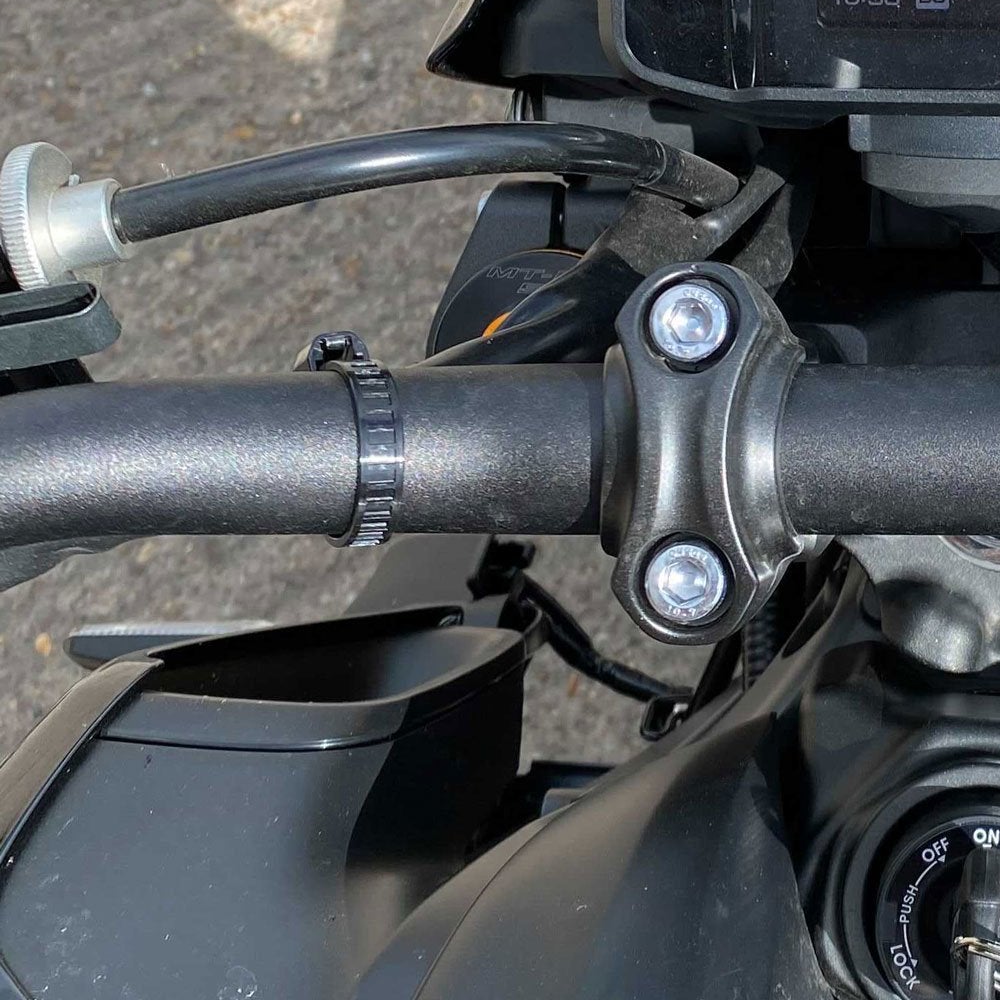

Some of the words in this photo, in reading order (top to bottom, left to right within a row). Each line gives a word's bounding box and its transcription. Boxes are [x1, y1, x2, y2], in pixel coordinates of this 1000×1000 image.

[486, 265, 563, 281] MT-
[973, 828, 1000, 845] ON
[921, 837, 949, 863] OFF
[899, 884, 918, 924] PUSH
[890, 944, 921, 991] LOCK
